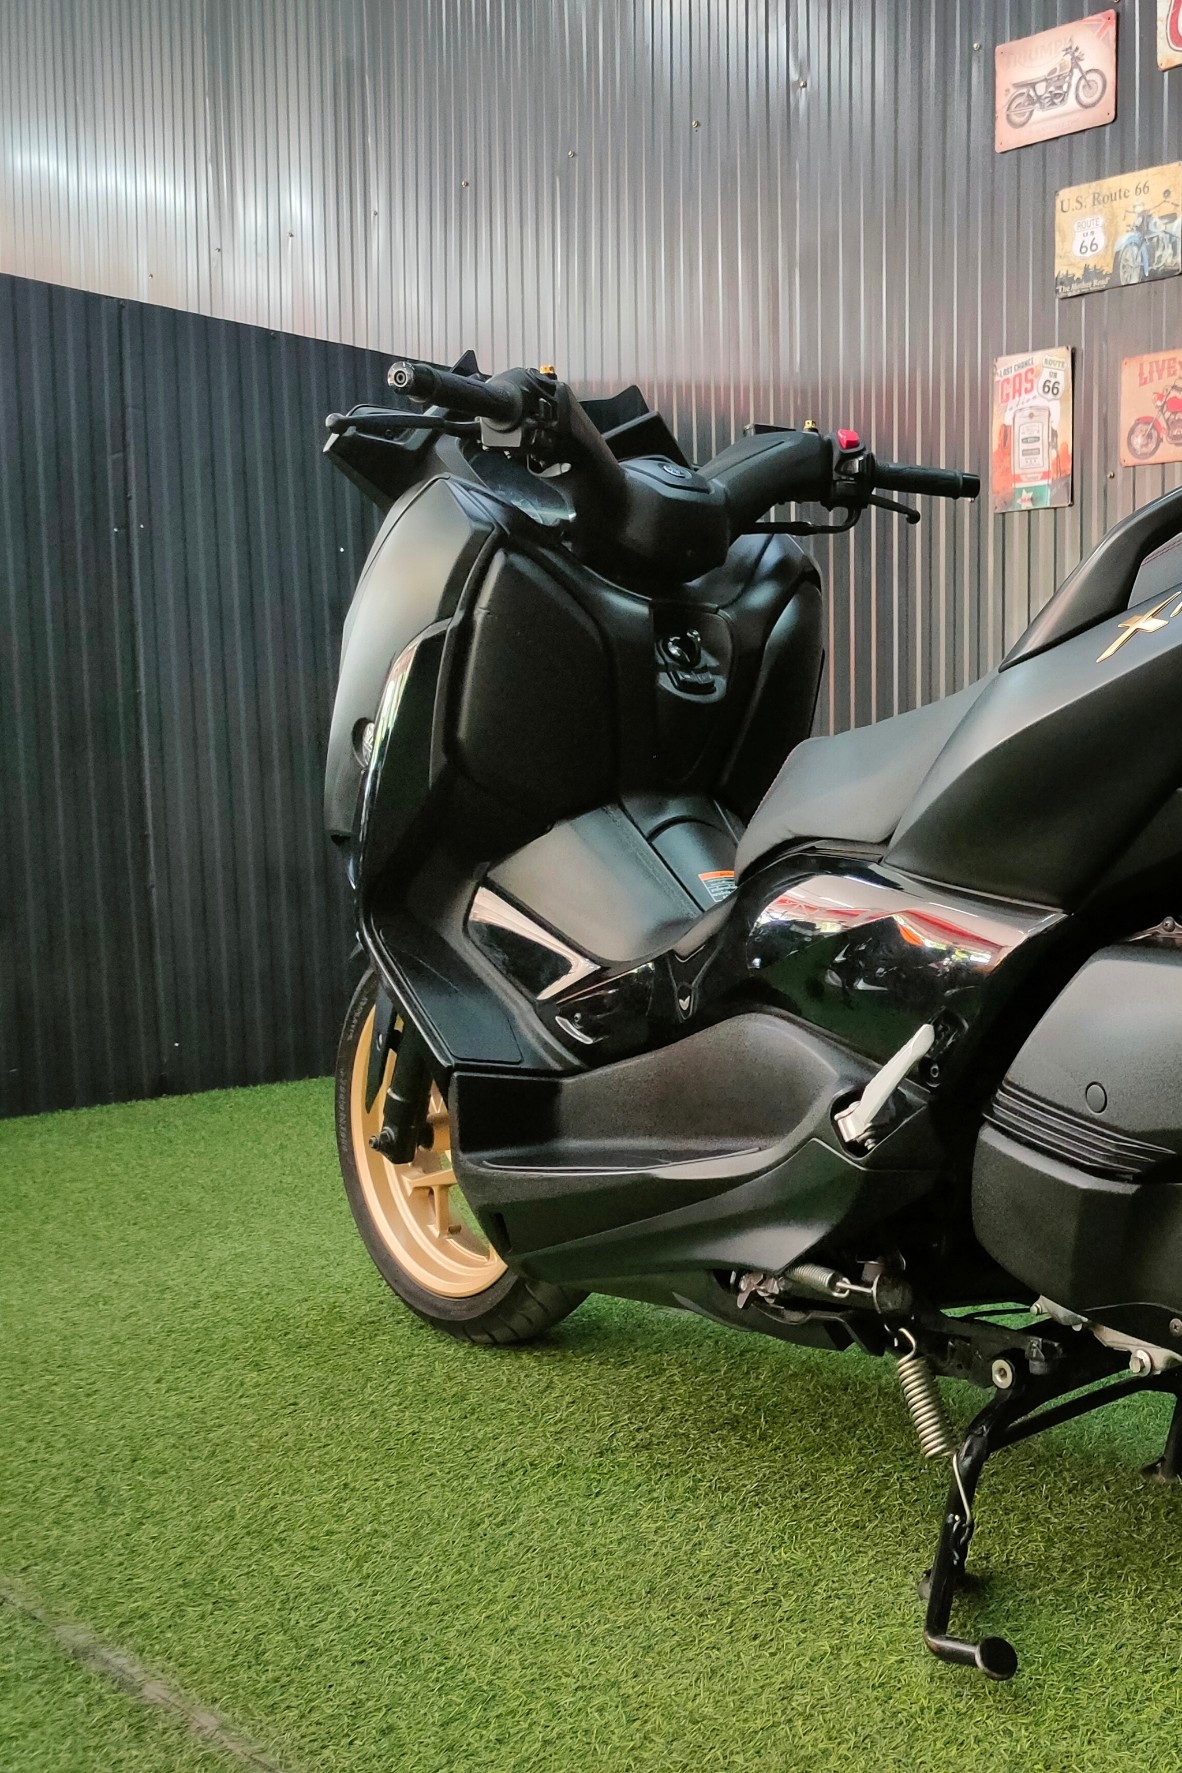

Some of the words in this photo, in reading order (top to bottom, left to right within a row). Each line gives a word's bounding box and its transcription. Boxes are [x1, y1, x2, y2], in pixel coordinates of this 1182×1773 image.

[1060, 196, 1086, 213] U.S.
[1092, 188, 1130, 207] Route
[1135, 181, 1150, 196] 66
[1076, 218, 1100, 230] ROUTE
[1080, 238, 1099, 255] 66
[1044, 358, 1065, 368] ROUTE
[1139, 357, 1177, 387] LIVE
[1000, 367, 1035, 404] GAS
[1042, 380, 1060, 396] 66
